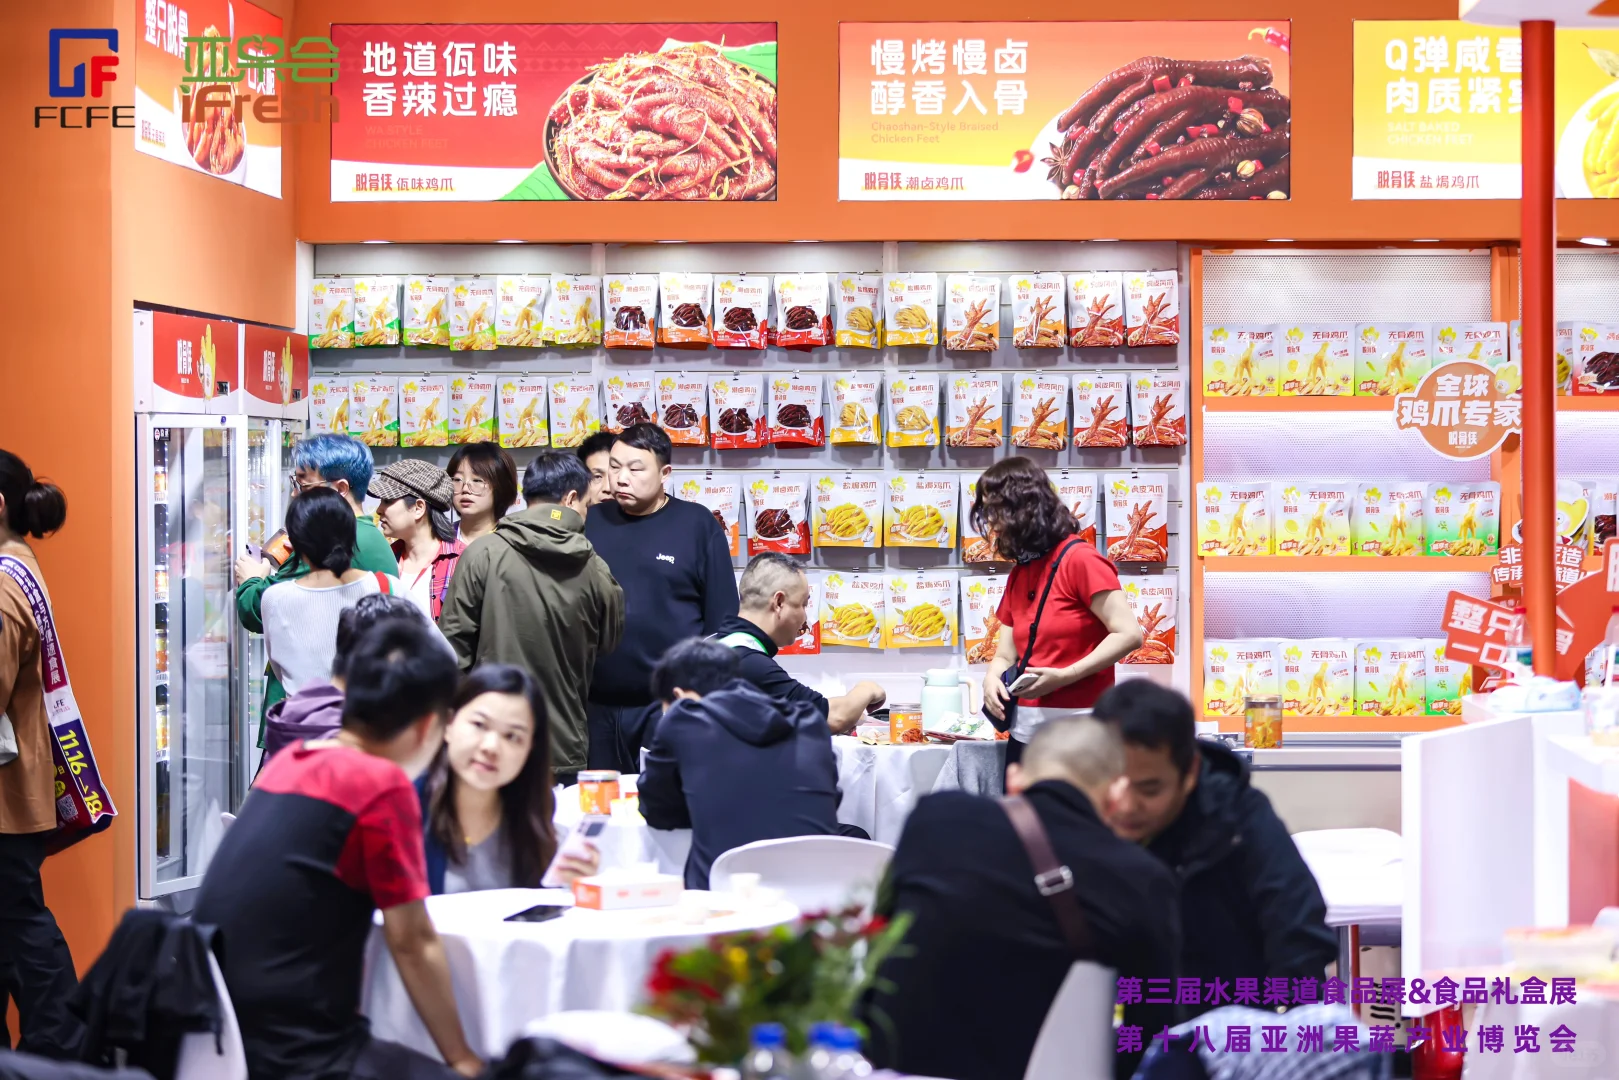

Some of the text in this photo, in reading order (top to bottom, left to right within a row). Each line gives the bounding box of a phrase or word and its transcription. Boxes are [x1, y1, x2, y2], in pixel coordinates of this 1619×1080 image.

[362, 41, 518, 78] 地道佤味
[870, 39, 1029, 76] 慢烤慢卤
[1385, 36, 1522, 74] Q弹咸香
[362, 80, 518, 117] 香辣过瘾
[870, 79, 1029, 116] 醇香入骨
[871, 121, 999, 134] Chaoshan-Style Braised
[1387, 121, 1460, 133] SALT BAKED
[871, 133, 940, 144] Chicken Feet
[1387, 134, 1473, 145] CHICKEN FEET
[396, 176, 454, 192] 佤味鸡爪
[905, 176, 964, 191] 潮卤鸡爪
[1419, 175, 1480, 189] 盐焗鸡爪
[1435, 373, 1490, 397] 全球
[1399, 399, 1522, 427] 鸡爪专家
[1309, 491, 1345, 499] 无骨鸡爪
[656, 553, 675, 564] Jeep
[59, 729, 89, 776] 11.16
[84, 790, 103, 815] 18
